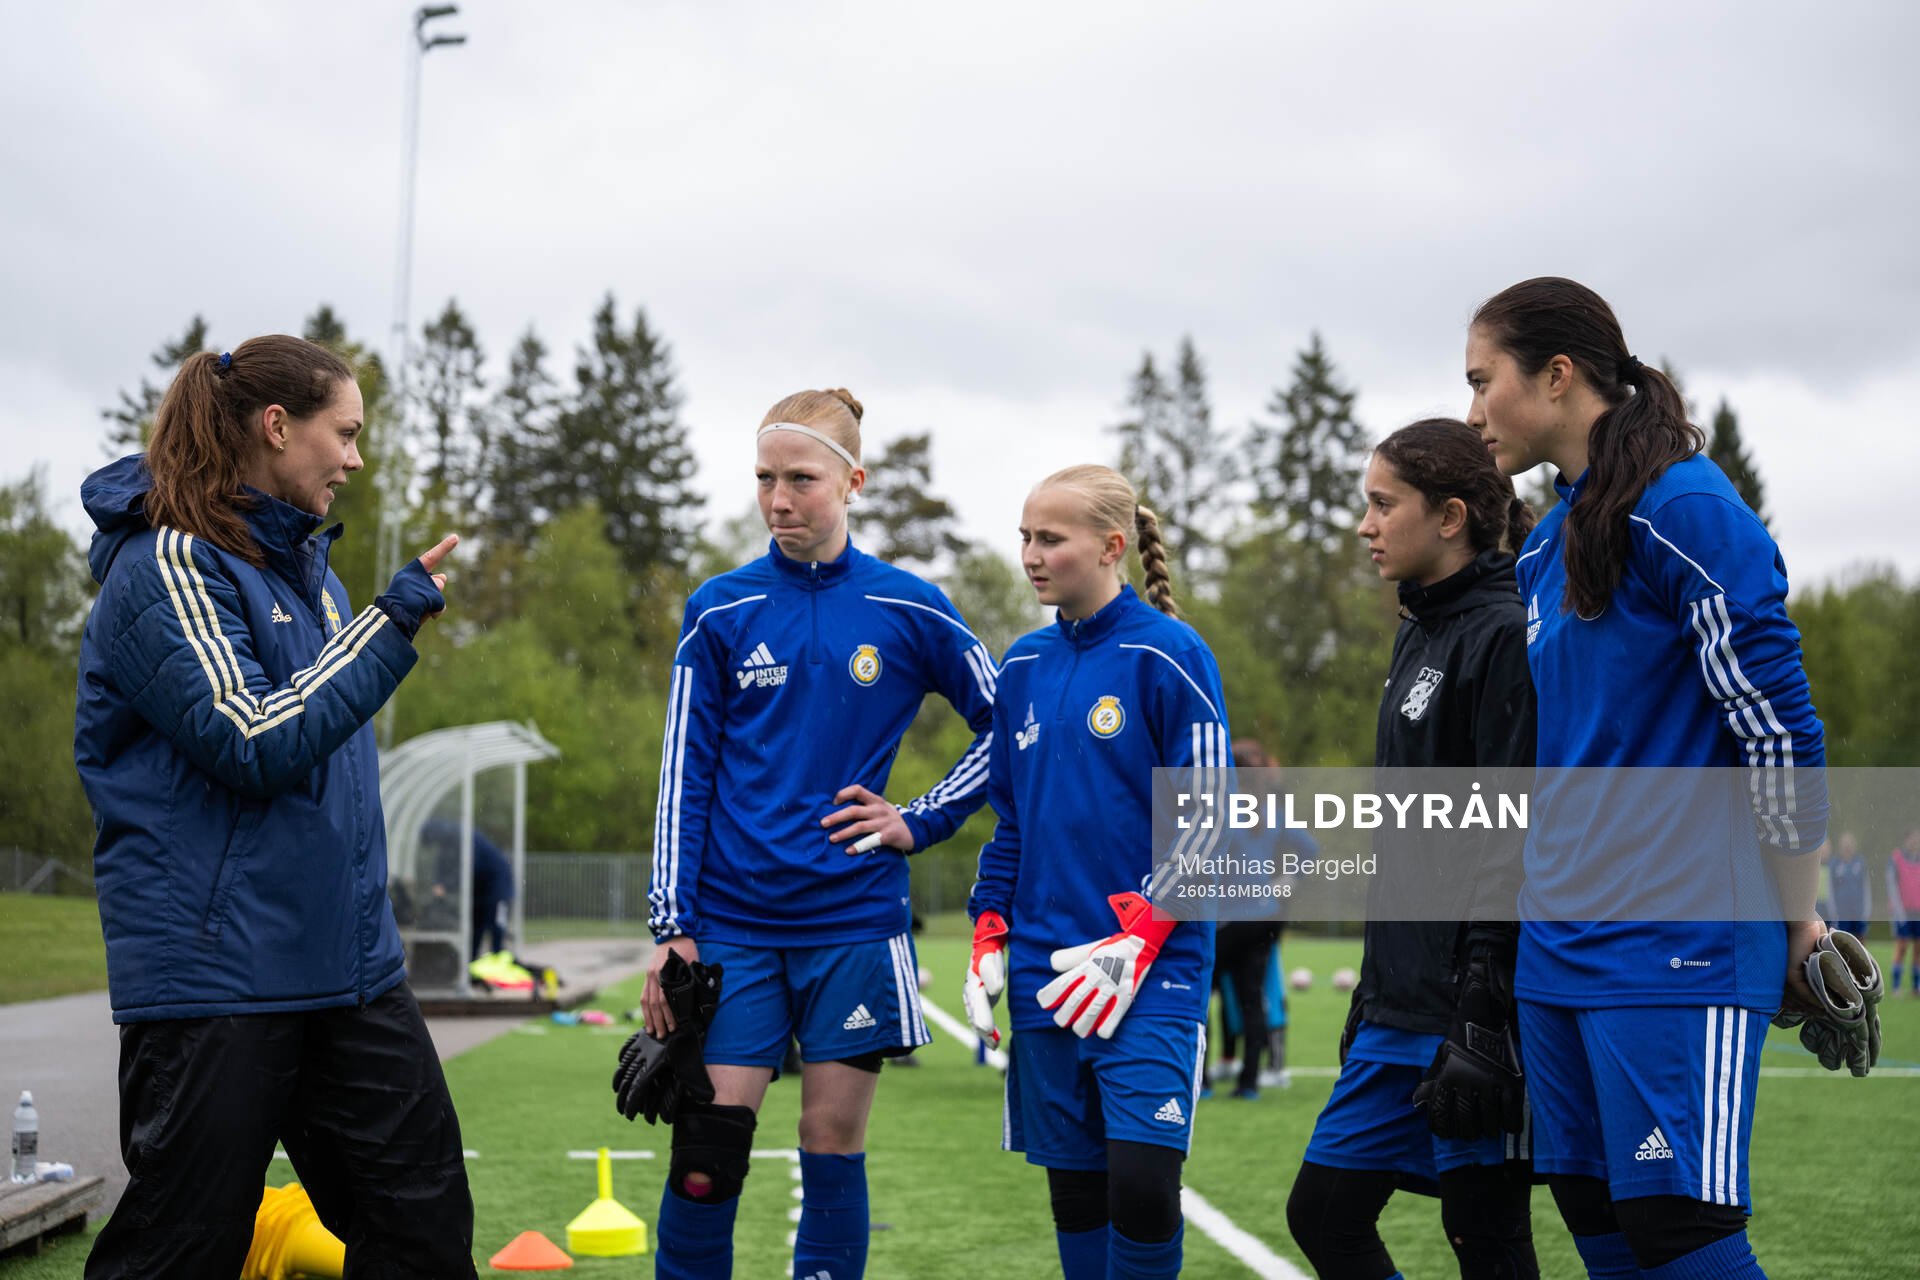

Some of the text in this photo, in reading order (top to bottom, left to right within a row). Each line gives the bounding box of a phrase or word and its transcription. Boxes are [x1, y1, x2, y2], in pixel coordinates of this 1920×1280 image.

[755, 666, 788, 679] INTER
[756, 676, 787, 688] SPORT
[1154, 1111, 1186, 1126] adidas
[1634, 1147, 1674, 1161] adidas
